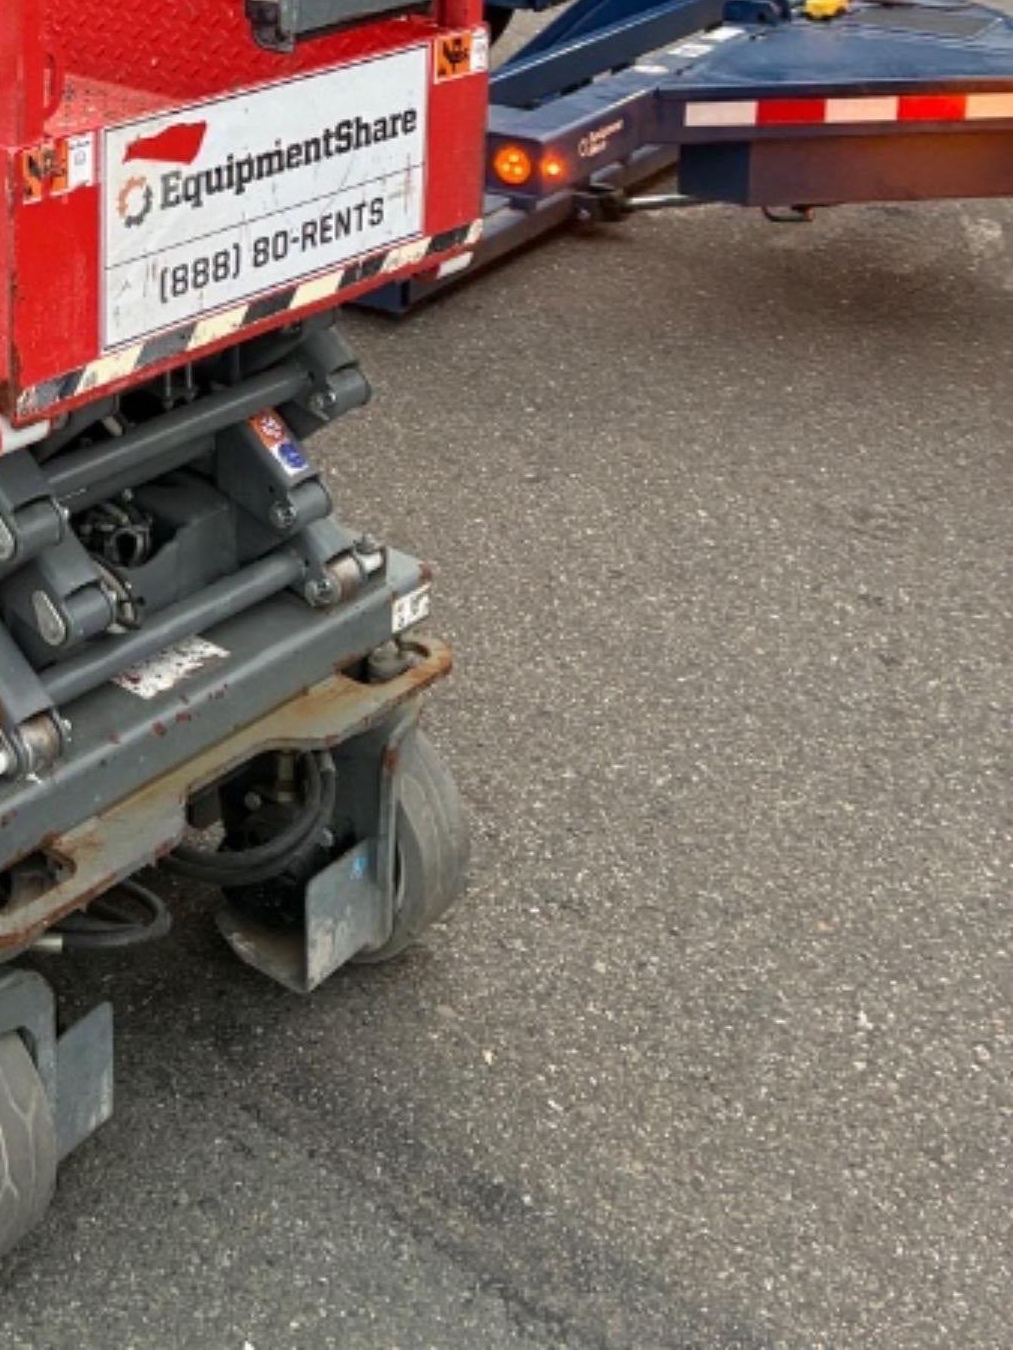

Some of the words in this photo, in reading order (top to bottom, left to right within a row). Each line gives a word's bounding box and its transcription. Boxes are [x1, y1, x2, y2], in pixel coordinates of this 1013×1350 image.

[159, 108, 417, 210] EquipmentShare
[159, 243, 242, 304] (888)
[252, 197, 385, 268] 80-RENTS
